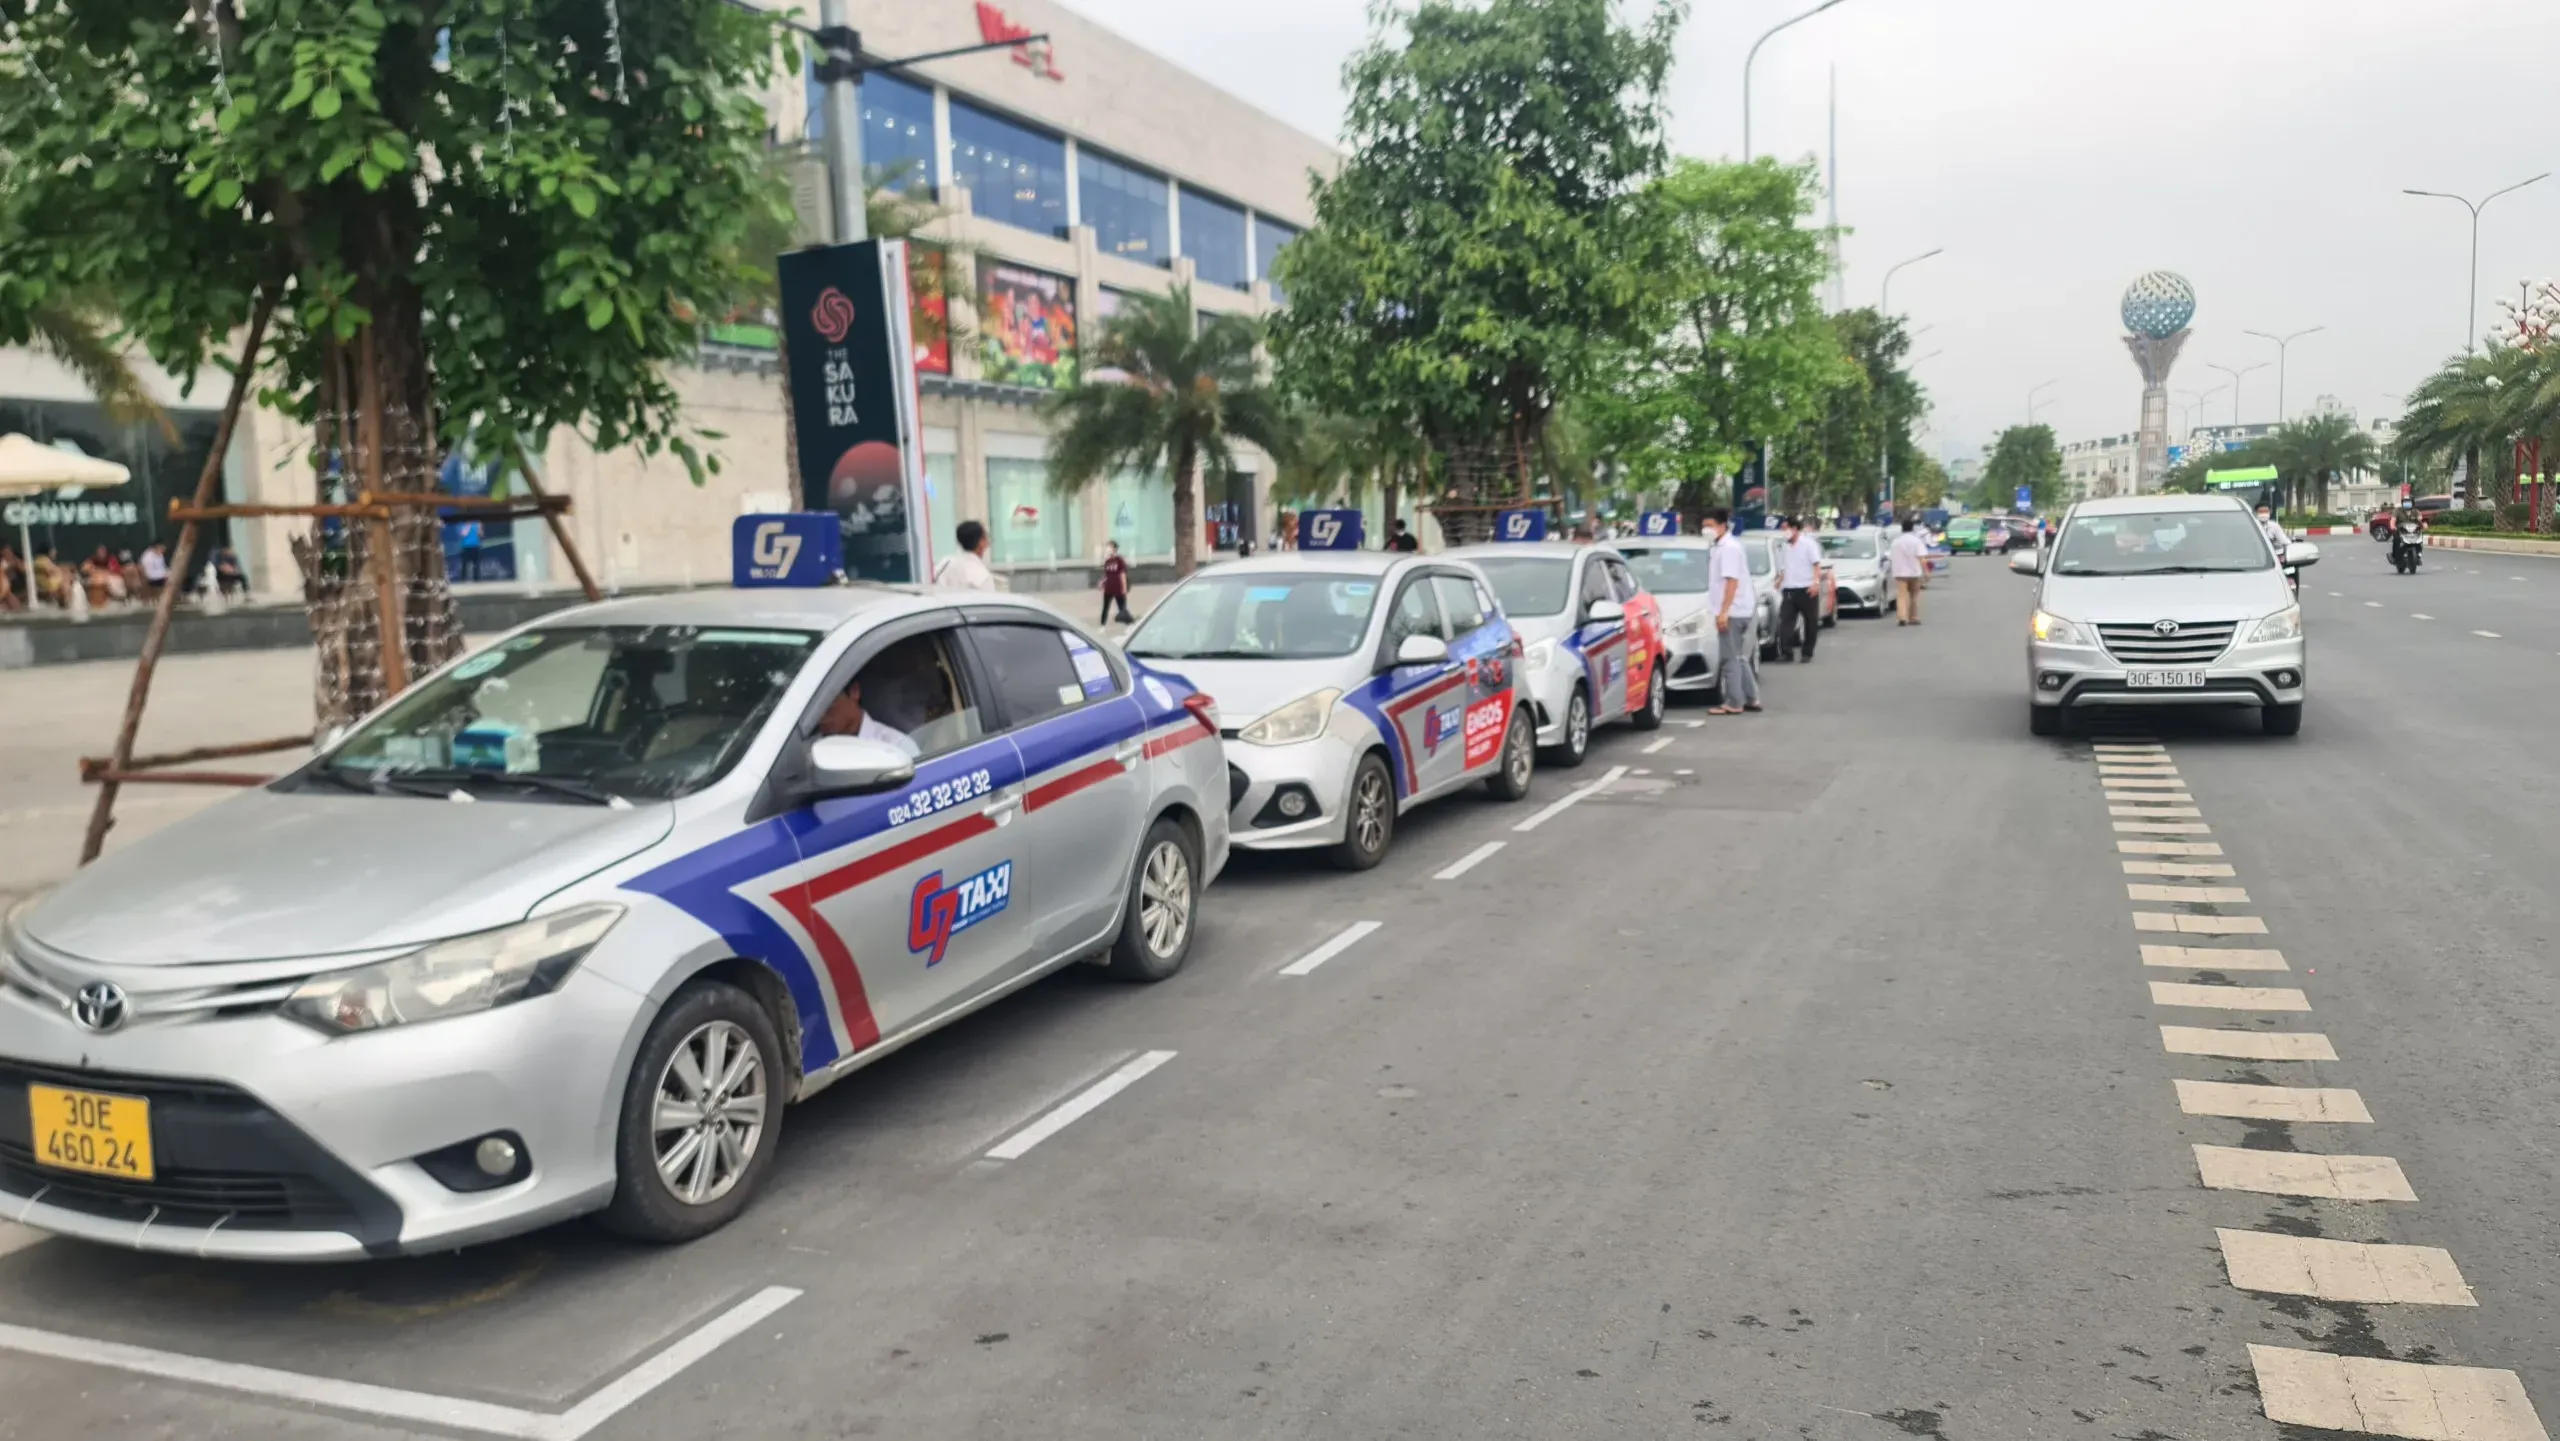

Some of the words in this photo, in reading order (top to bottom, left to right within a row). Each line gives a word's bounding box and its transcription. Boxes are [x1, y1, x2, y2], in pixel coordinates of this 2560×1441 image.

[828, 348, 849, 361] THE
[823, 361, 854, 383] SA
[826, 383, 856, 404] KU
[828, 405, 859, 428] RA
[3, 501, 138, 526] CONVERSE
[1311, 513, 1342, 547] G7
[1507, 514, 1532, 539] G7
[753, 521, 803, 580] G7
[2128, 671, 2204, 686] 30E-150.16
[908, 869, 959, 968] G7
[957, 863, 1011, 917] TAXI
[63, 1093, 113, 1132] 30E
[47, 1129, 138, 1172] 460.24
